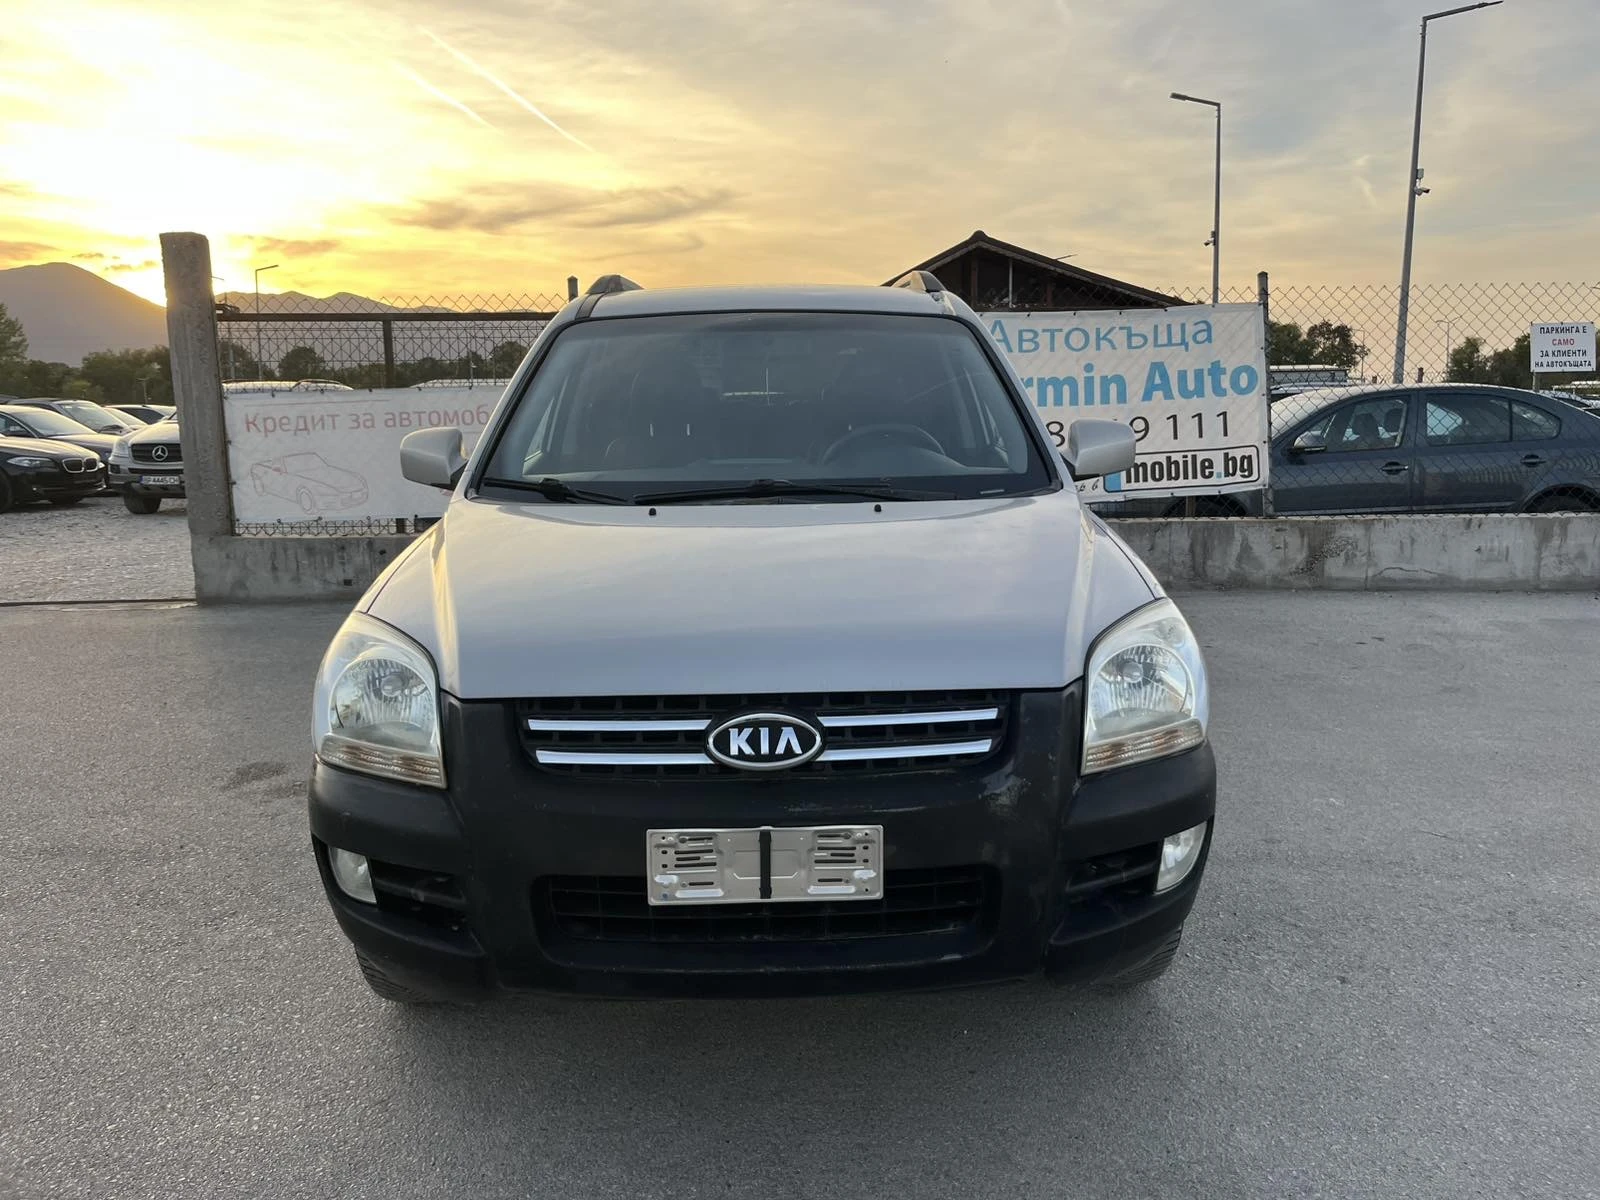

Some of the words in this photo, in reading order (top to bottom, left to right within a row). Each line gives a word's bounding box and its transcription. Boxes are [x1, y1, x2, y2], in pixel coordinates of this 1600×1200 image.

[991, 319, 1213, 353] Автокъща
[1540, 326, 1580, 334] ПАРКИНГА
[1141, 359, 1259, 402] Auto
[348, 410, 377, 430] за
[1166, 410, 1229, 440] 111
[1125, 452, 1254, 484] mobile.bg
[728, 727, 803, 756] KIA
